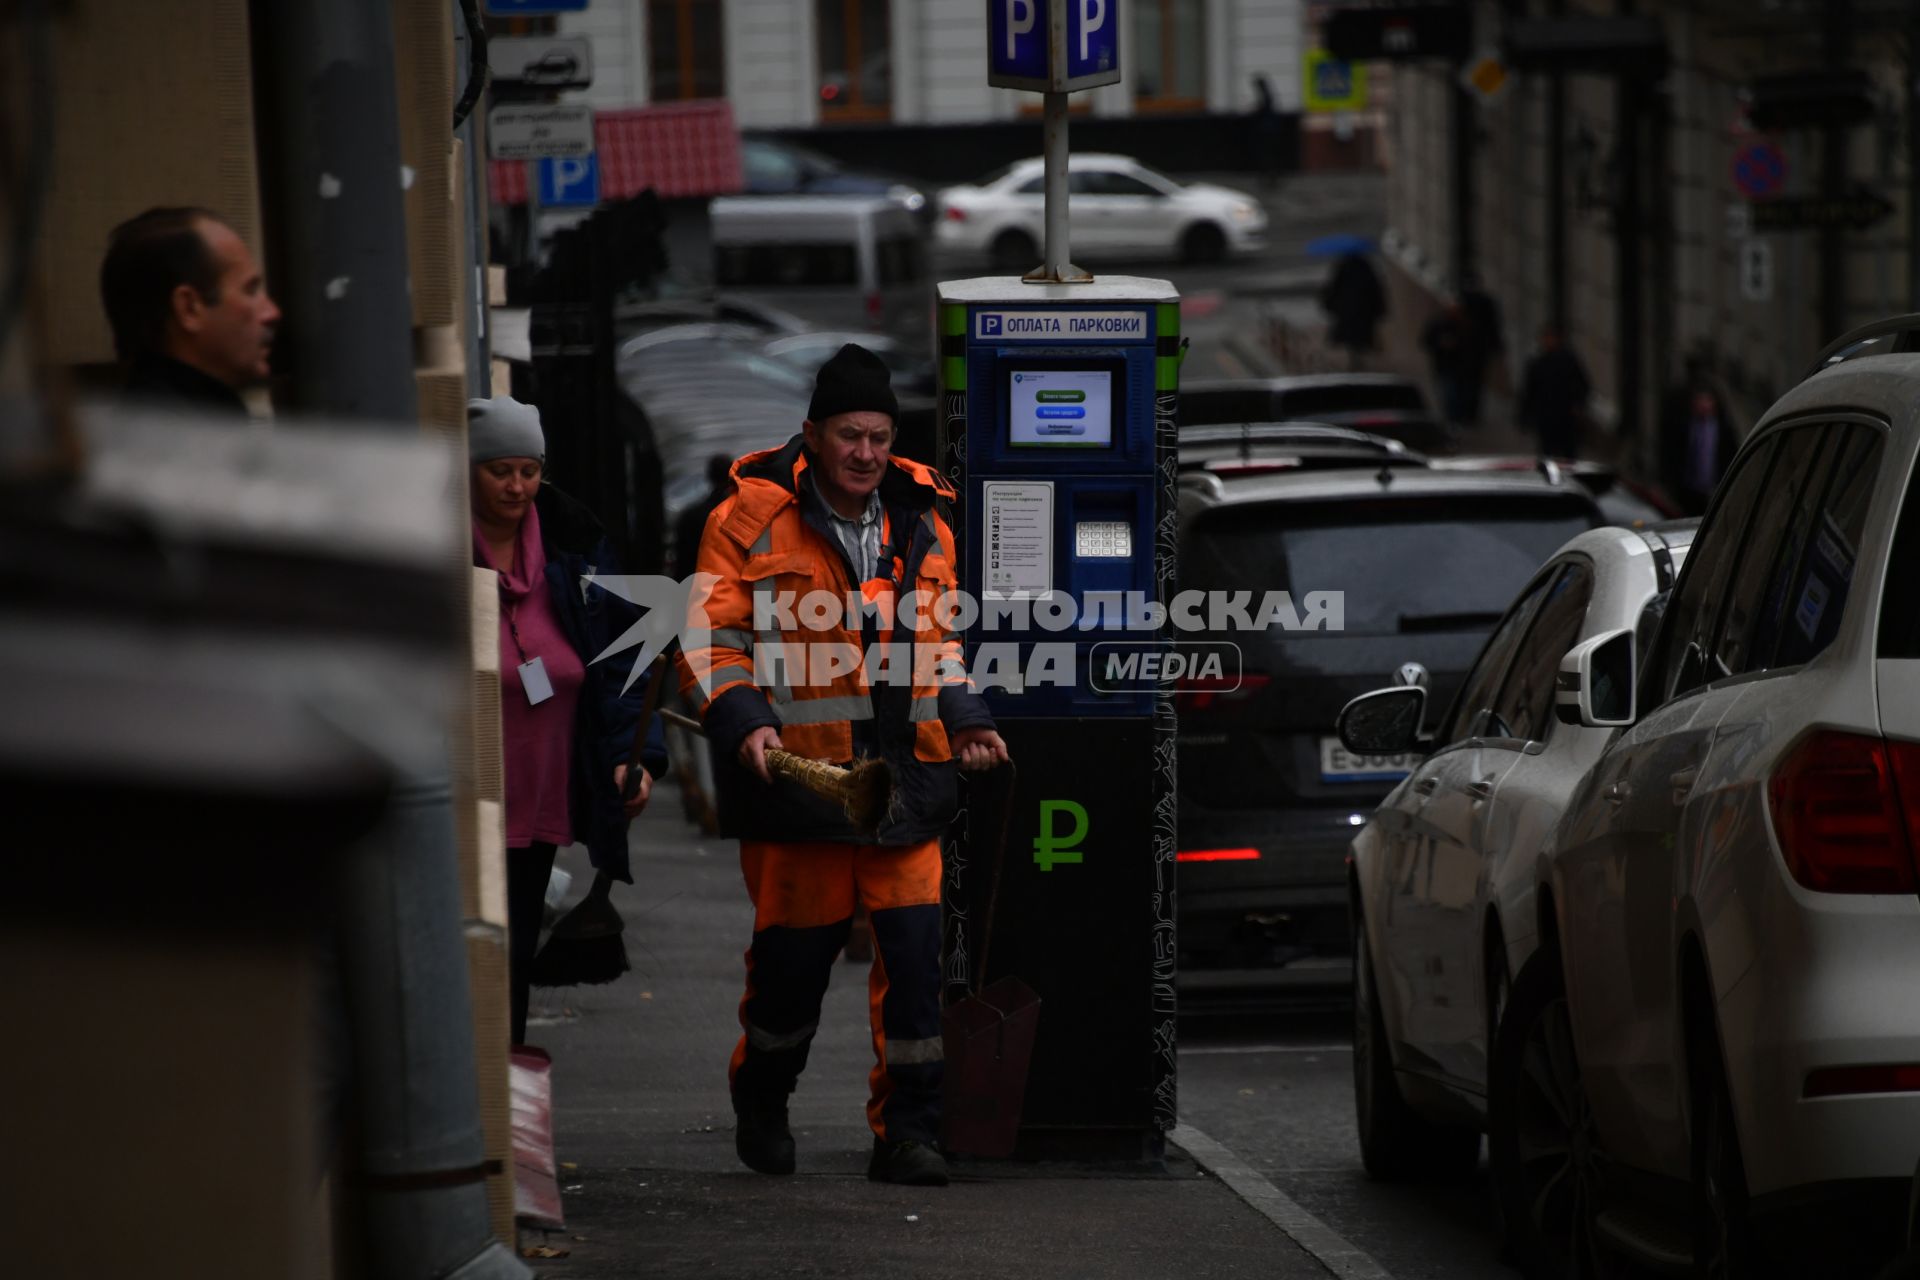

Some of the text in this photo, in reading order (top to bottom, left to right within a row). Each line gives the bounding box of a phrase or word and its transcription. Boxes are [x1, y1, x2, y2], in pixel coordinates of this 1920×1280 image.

[1006, 0, 1035, 60] P
[1079, 0, 1106, 61] P
[986, 318, 998, 333] P
[1007, 318, 1140, 332] ОПЛАТА ПАРКОВКИ
